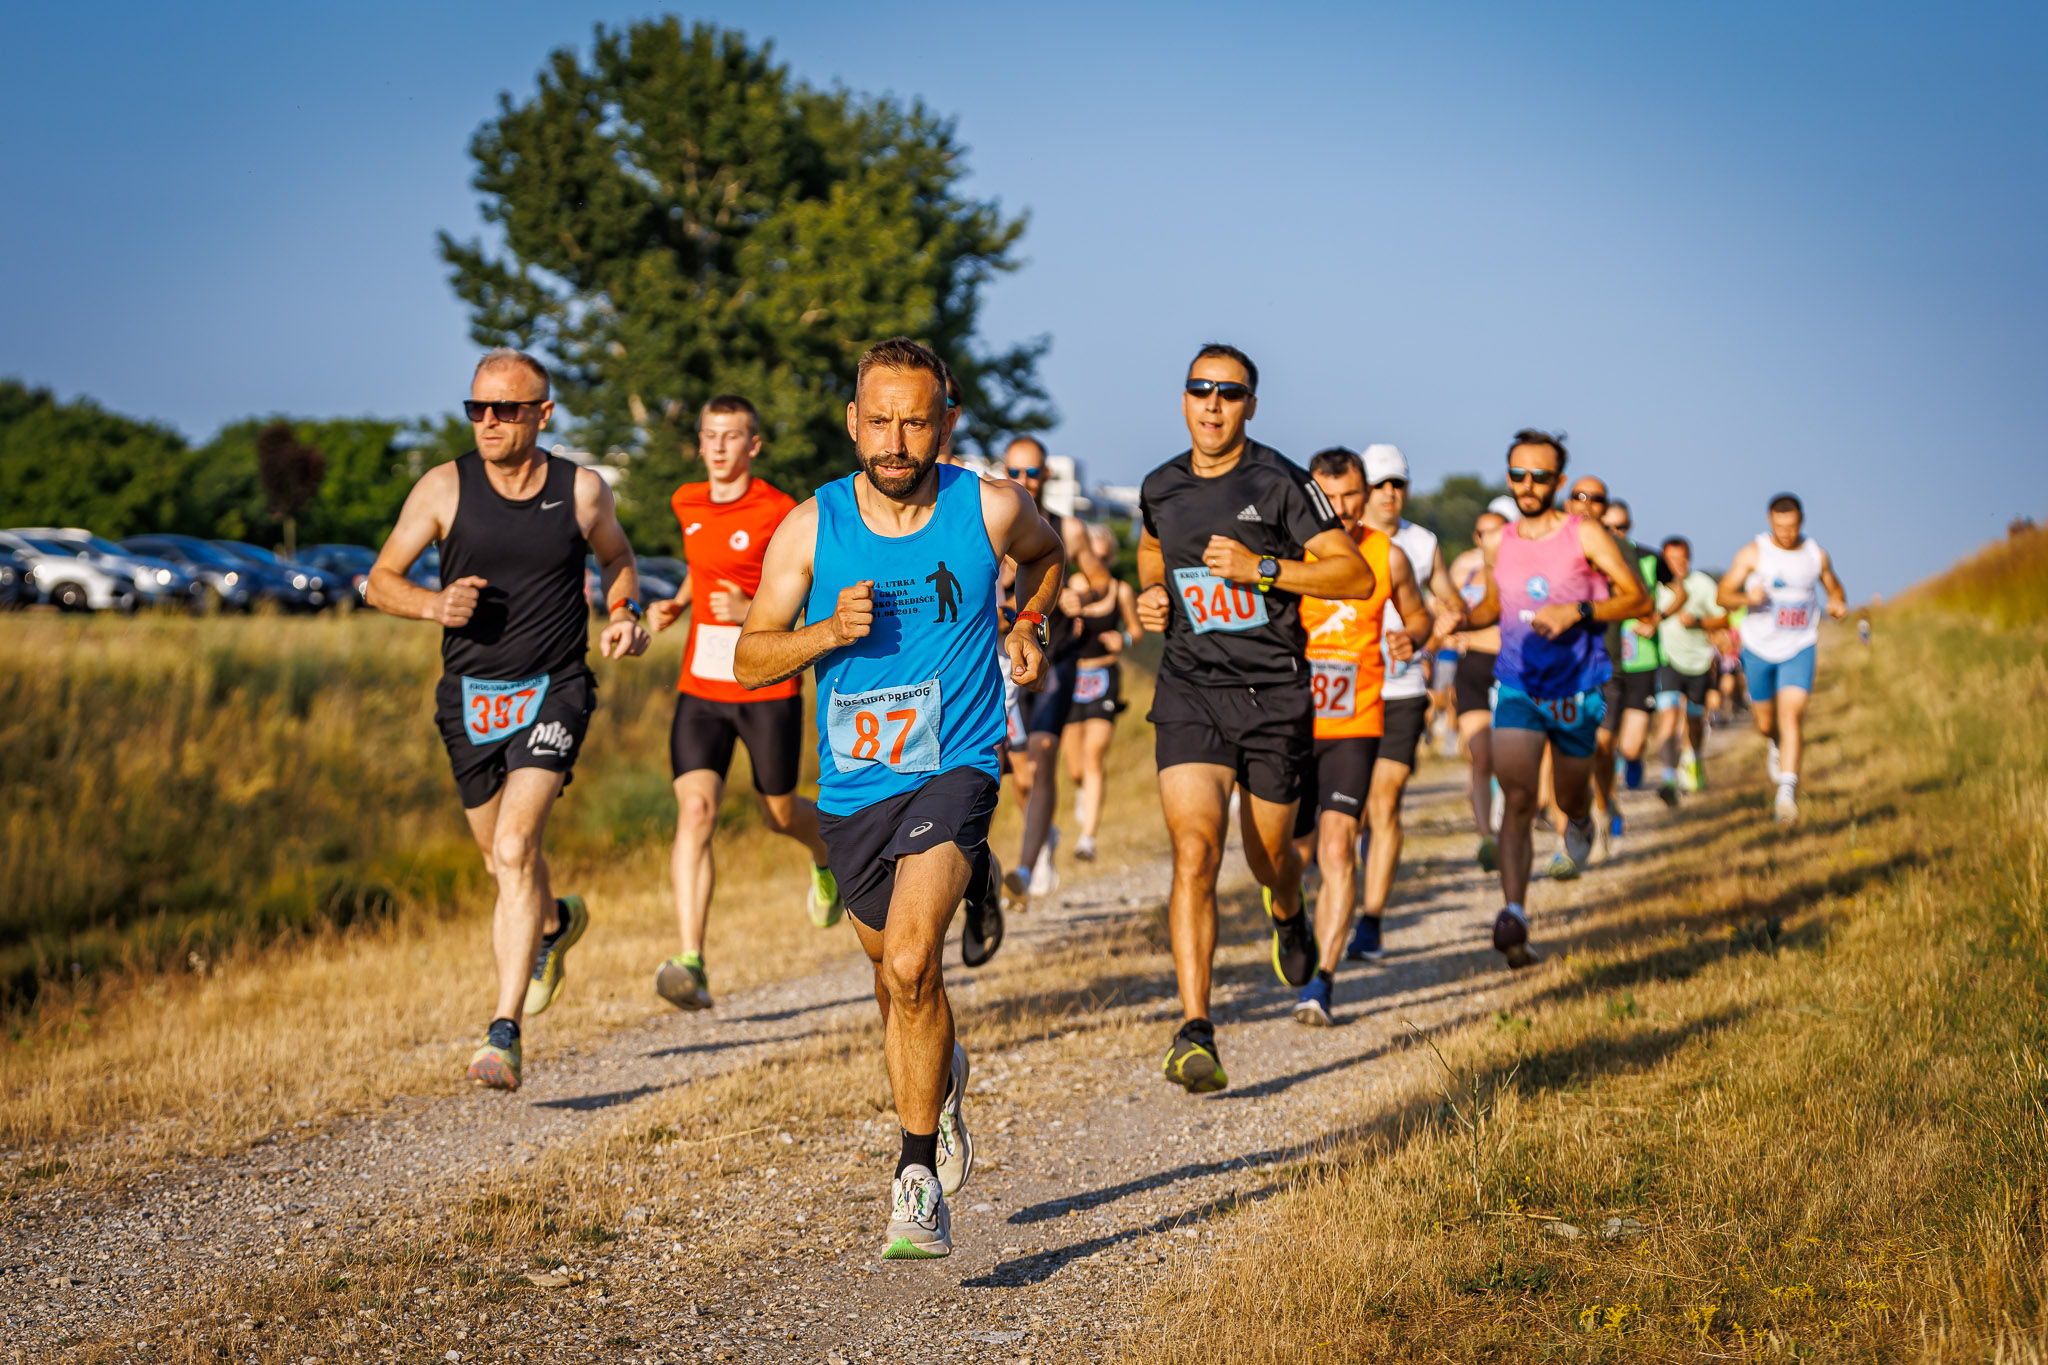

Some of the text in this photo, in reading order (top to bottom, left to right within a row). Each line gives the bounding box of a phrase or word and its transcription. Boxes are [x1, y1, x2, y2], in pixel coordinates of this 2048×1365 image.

[879, 589, 908, 598] GRADA
[885, 578, 916, 588] UTRKA
[873, 601, 891, 609] SKO
[1184, 582, 1255, 624] 340
[834, 697, 860, 707] ROS
[888, 686, 931, 702] PRELOG
[471, 688, 537, 734] 397
[851, 710, 917, 764] 87
